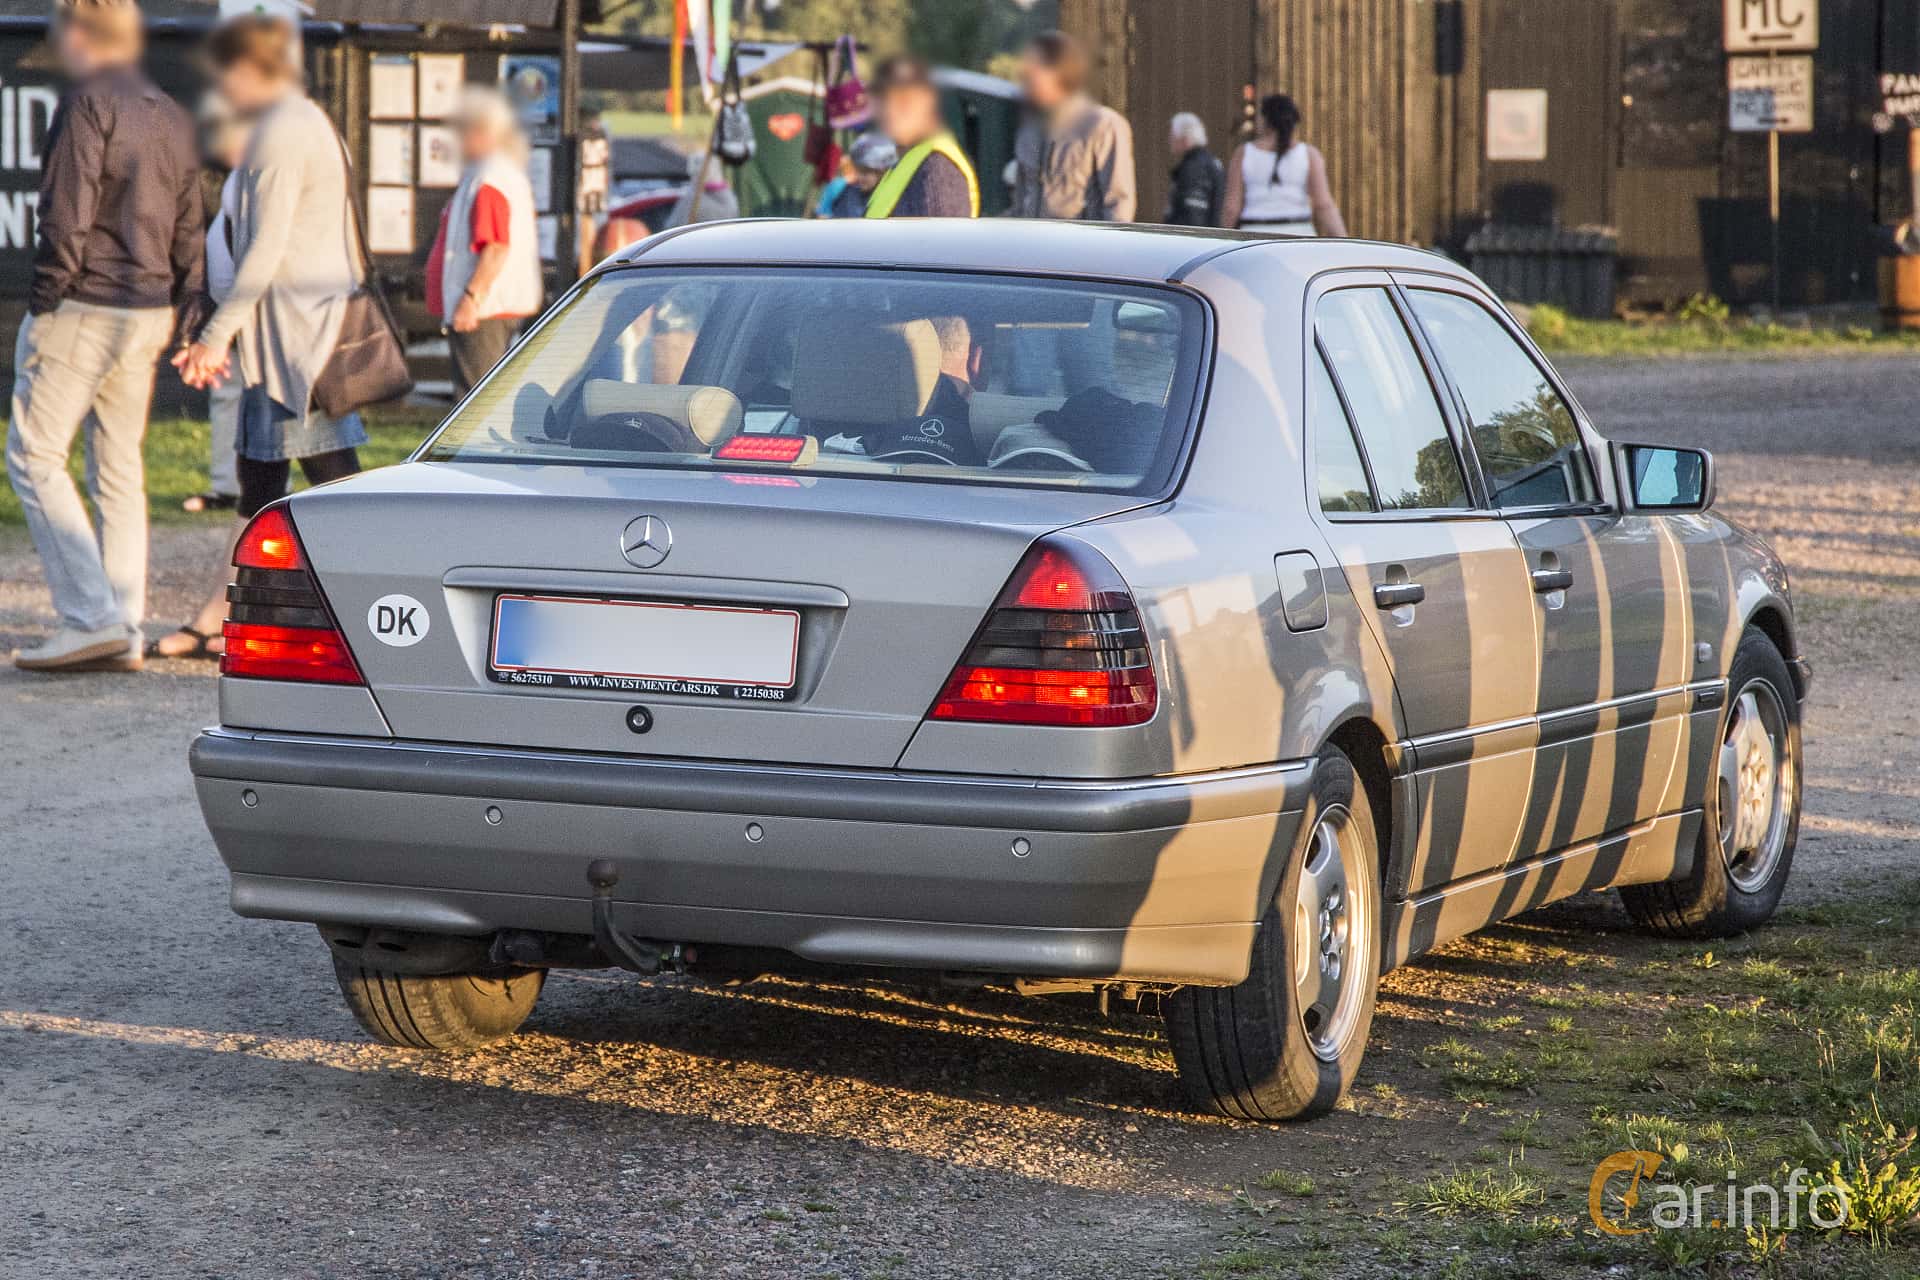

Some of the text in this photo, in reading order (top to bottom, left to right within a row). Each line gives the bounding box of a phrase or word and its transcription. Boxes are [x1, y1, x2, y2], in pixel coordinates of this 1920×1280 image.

[1740, 0, 1803, 30] MC
[377, 605, 418, 637] DK
[510, 673, 784, 701] 56275310 WWW.INVESTMENTCARS.DK 22150383
